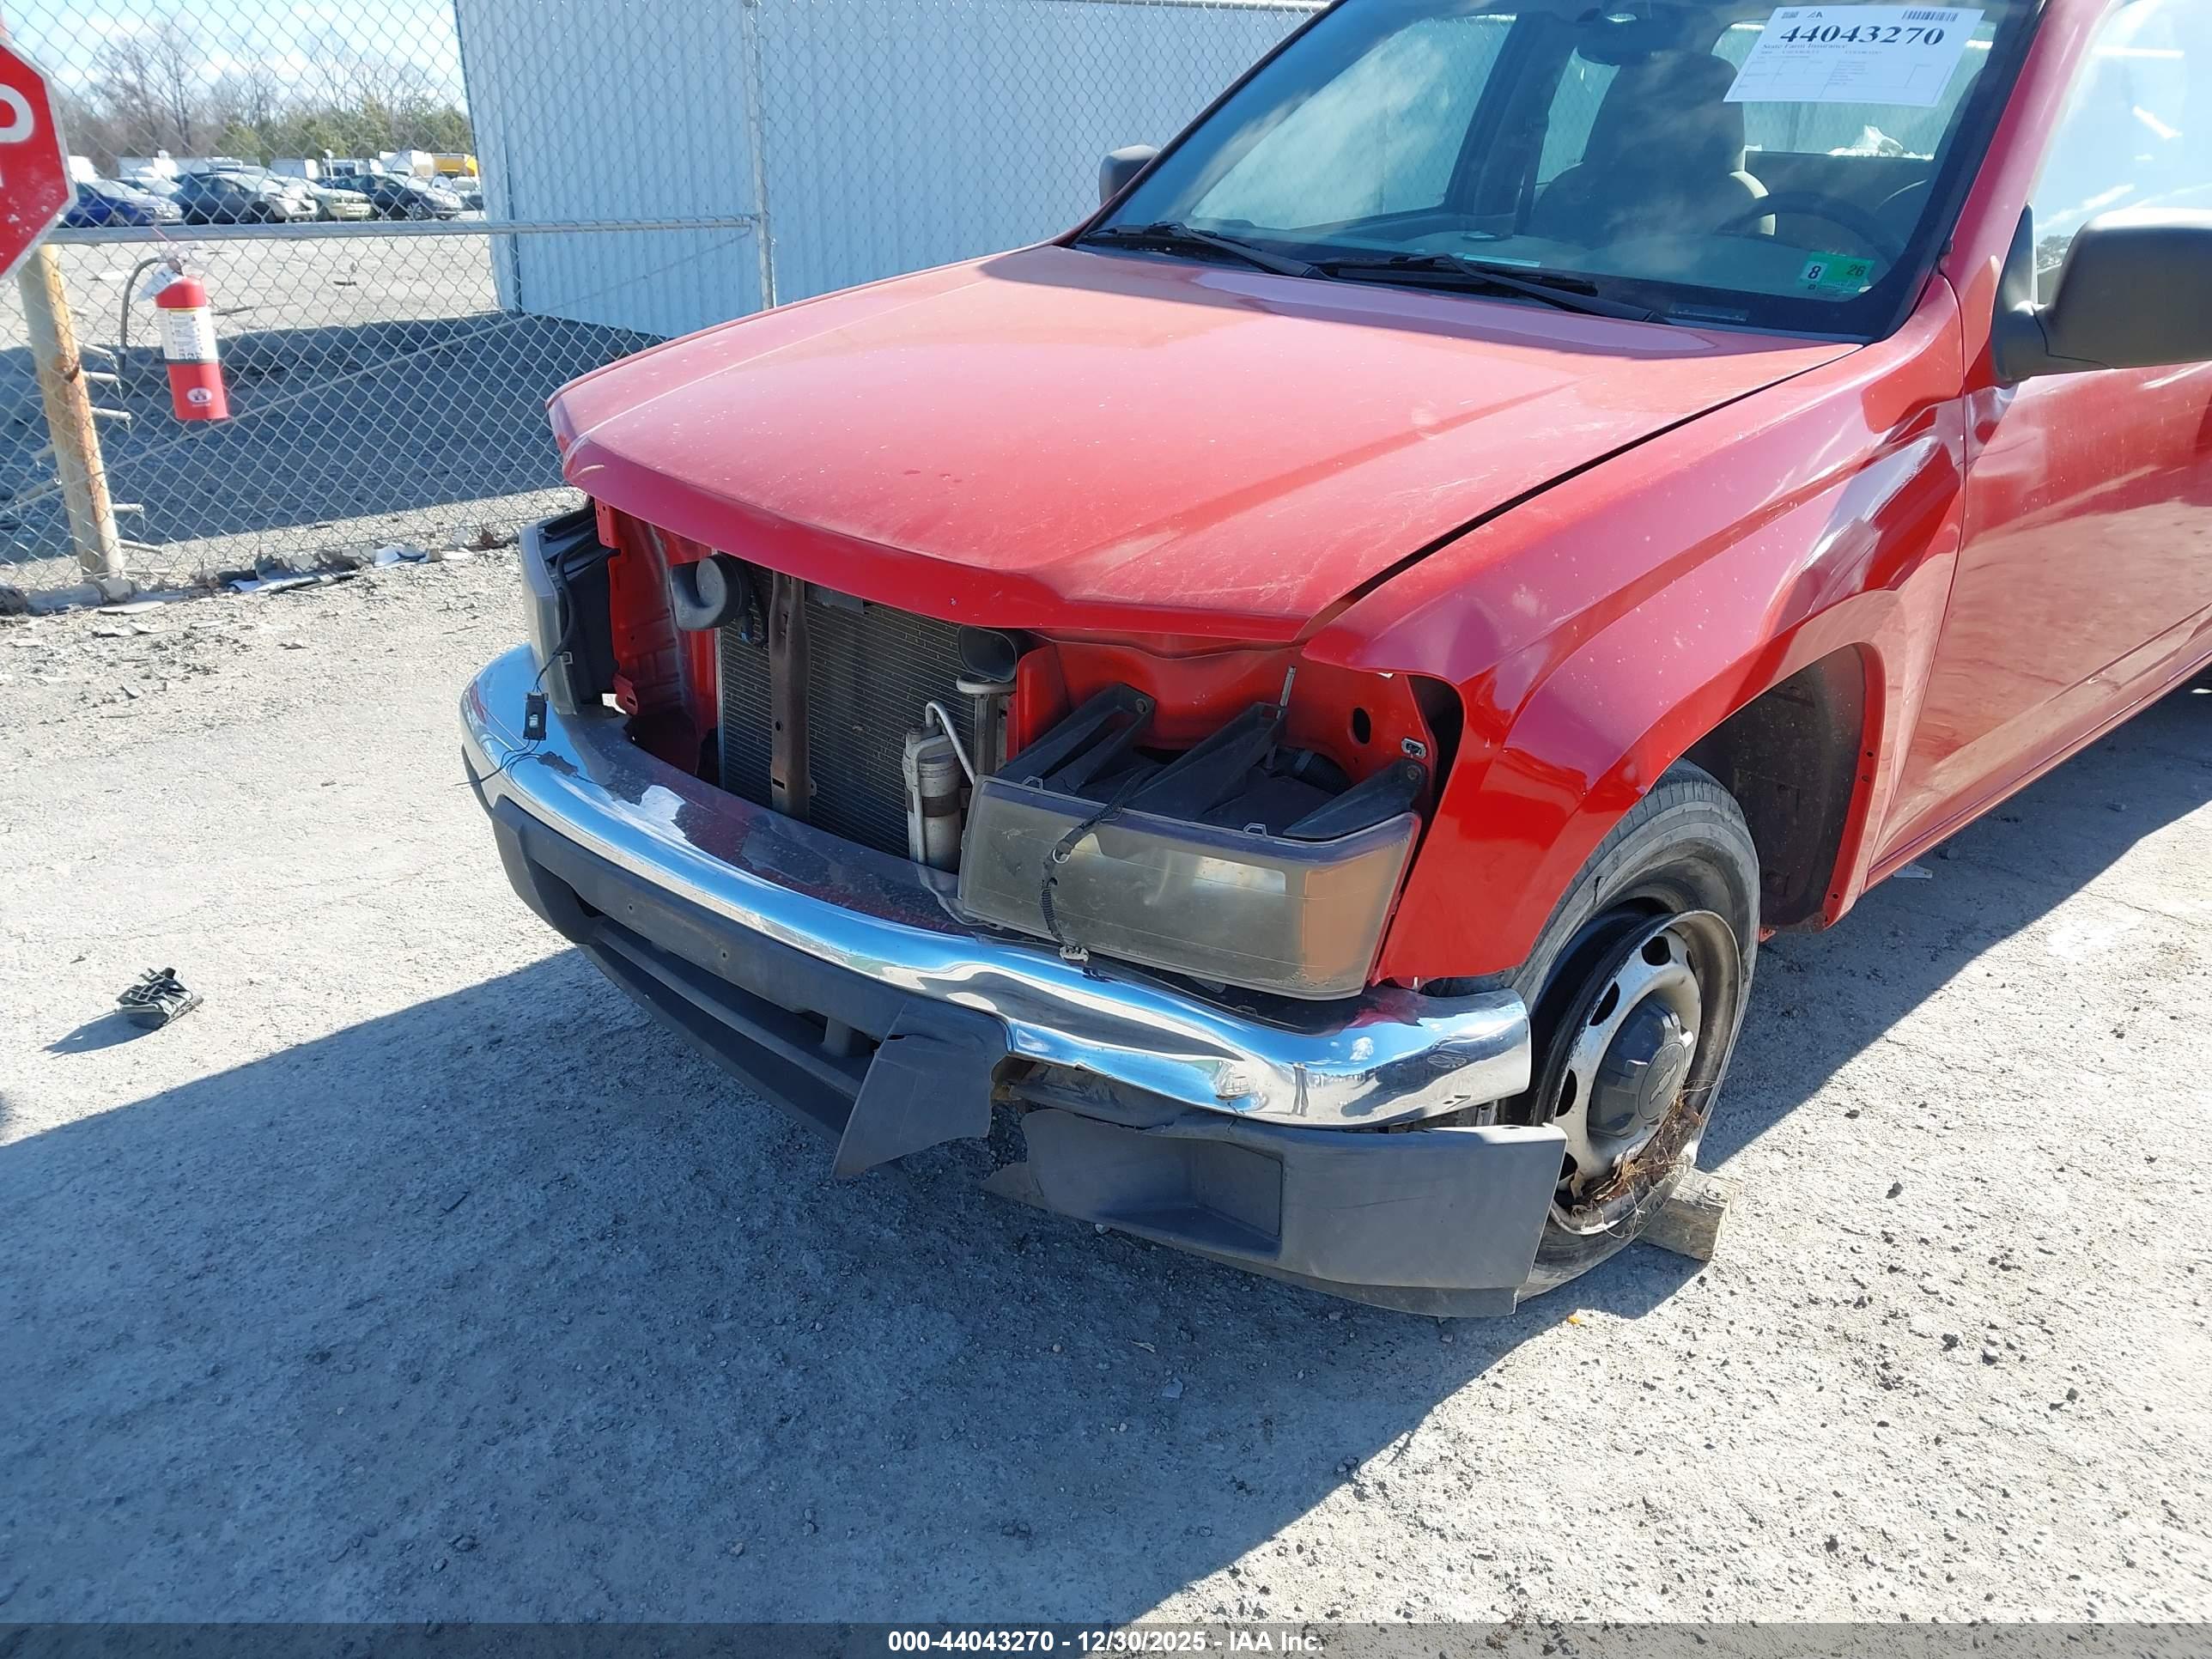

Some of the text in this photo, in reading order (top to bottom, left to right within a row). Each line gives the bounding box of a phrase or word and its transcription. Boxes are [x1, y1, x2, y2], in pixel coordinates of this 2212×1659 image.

[1779, 25, 1945, 46] 44043270
[1808, 264, 1867, 279] 8 26
